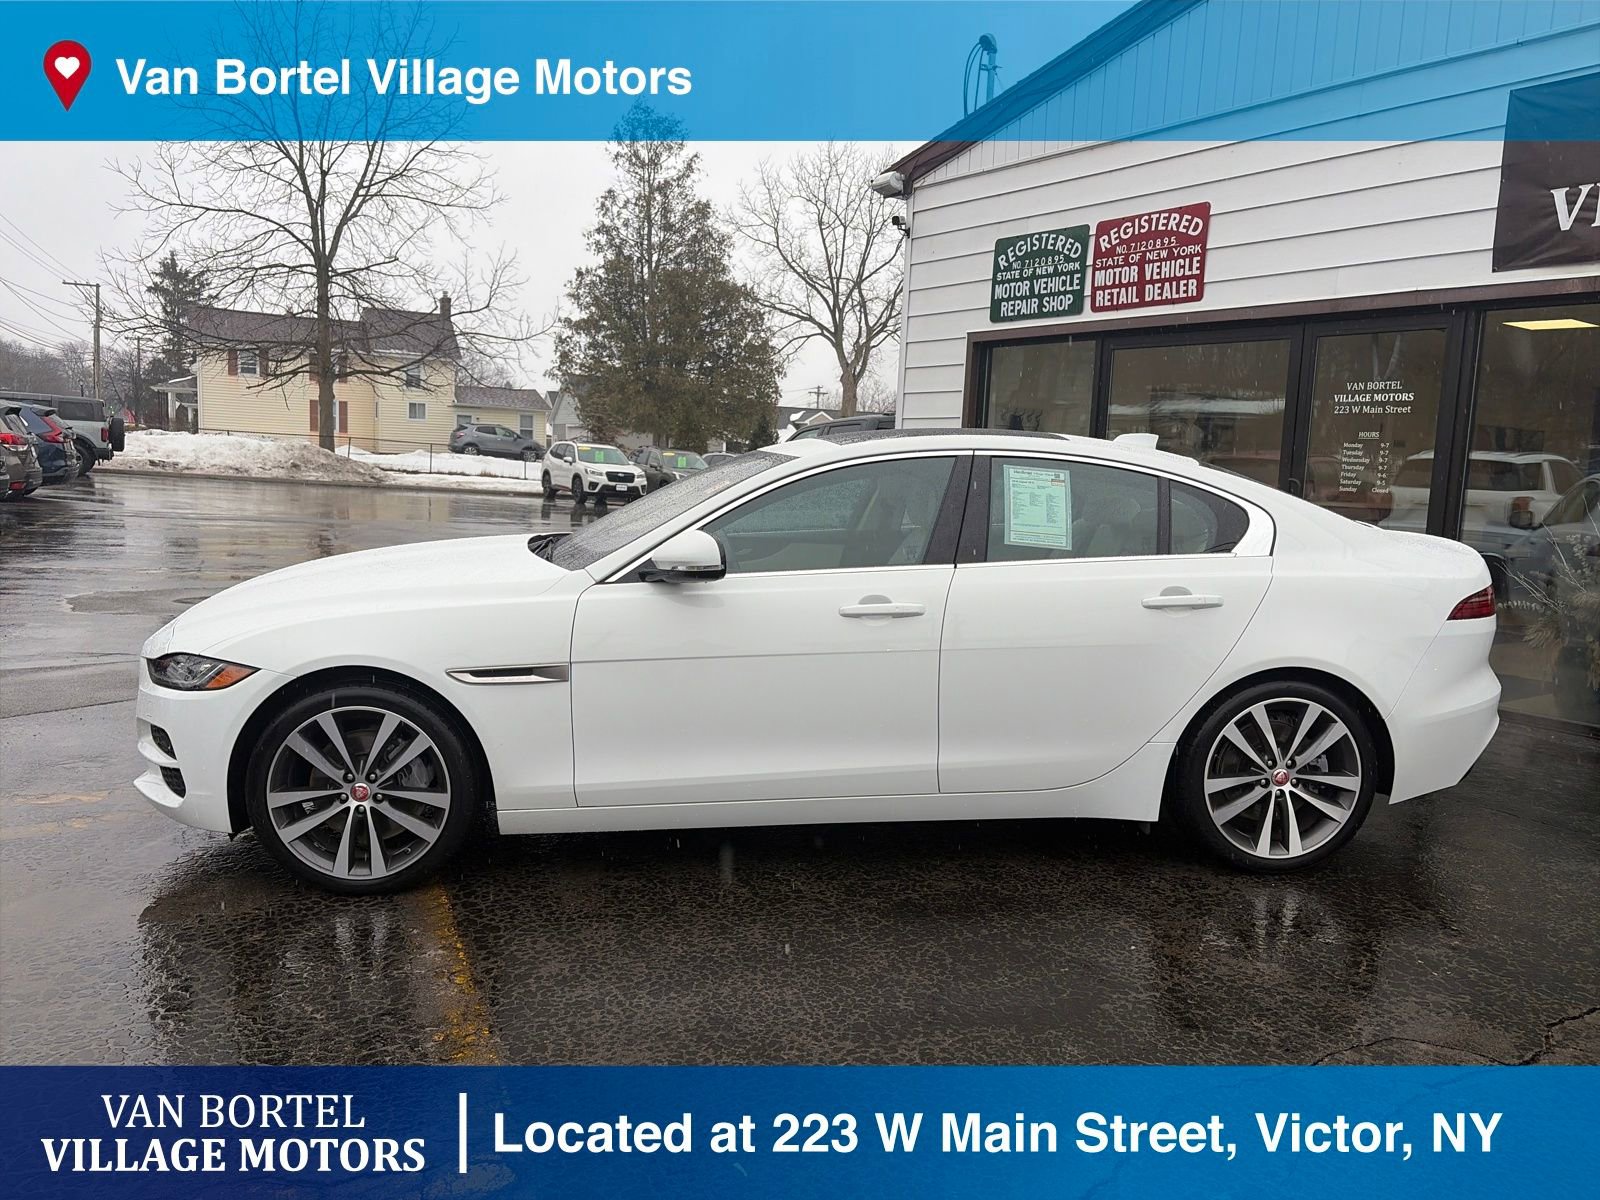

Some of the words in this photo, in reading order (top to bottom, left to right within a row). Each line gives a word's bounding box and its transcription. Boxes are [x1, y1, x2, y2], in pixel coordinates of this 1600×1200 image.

[1098, 213, 1203, 252] REGISTERED
[998, 233, 1082, 270] REGISTERED
[1129, 236, 1176, 252] 7120895
[1025, 254, 1064, 268] 7120895
[1095, 255, 1125, 268] STATE
[1128, 253, 1142, 263] OF
[1146, 249, 1168, 260] NEW
[1172, 244, 1202, 257] YORK
[996, 270, 1020, 281] STATE
[1022, 268, 1034, 278] OF
[1035, 265, 1054, 276] NEW
[1057, 261, 1080, 273] YORK
[1094, 265, 1138, 287] MOTOR
[1144, 256, 1201, 280] VEHICLE
[994, 280, 1030, 300] MOTOR
[1033, 273, 1081, 295] VEHICLE
[1095, 286, 1139, 307] RETAIL
[1144, 279, 1197, 302] DEALER
[1000, 298, 1038, 317] REPAIR
[1042, 294, 1074, 313] SHOP
[1346, 382, 1365, 391] VAN
[1366, 381, 1403, 390] BORTEL
[1334, 394, 1372, 403] VILLAGE
[1373, 392, 1415, 402] MOTORS
[1334, 406, 1350, 414] 223
[1351, 405, 1361, 414] W
[1362, 404, 1383, 414] Main
[1384, 404, 1412, 414] Street
[1343, 442, 1363, 450] Monday
[1343, 449, 1363, 457] Tuesday
